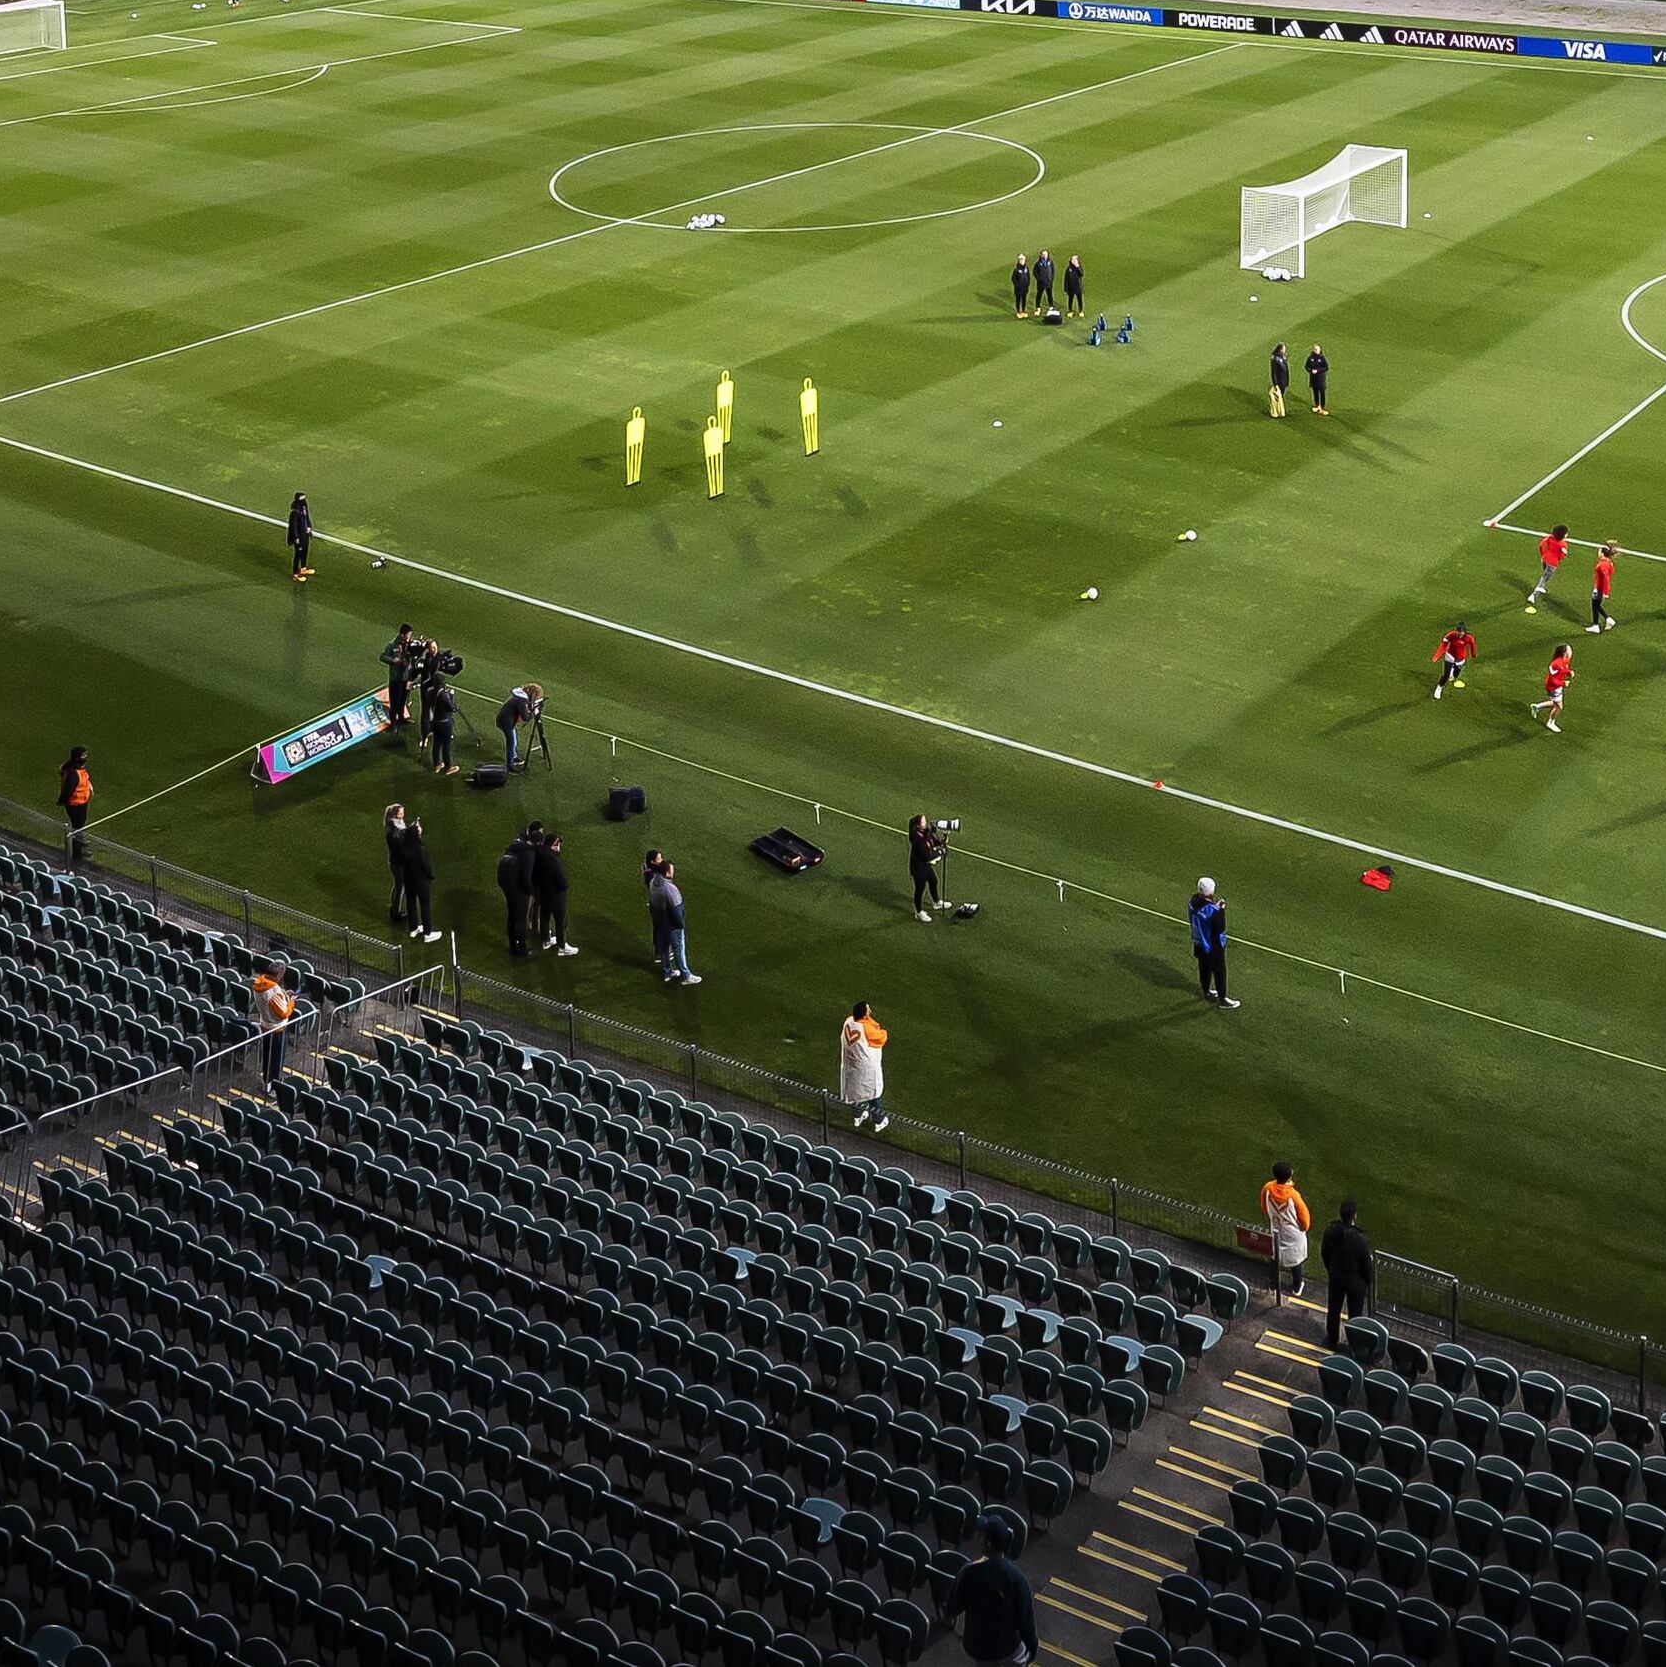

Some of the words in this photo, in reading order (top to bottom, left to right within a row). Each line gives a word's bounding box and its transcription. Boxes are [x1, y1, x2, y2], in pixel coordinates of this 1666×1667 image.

[1178, 13, 1255, 31] POWERADE
[1394, 29, 1445, 47] QATAR
[1449, 33, 1515, 52] AIRWAYS
[1562, 40, 1606, 60] VISA
[302, 731, 320, 745] FIFA
